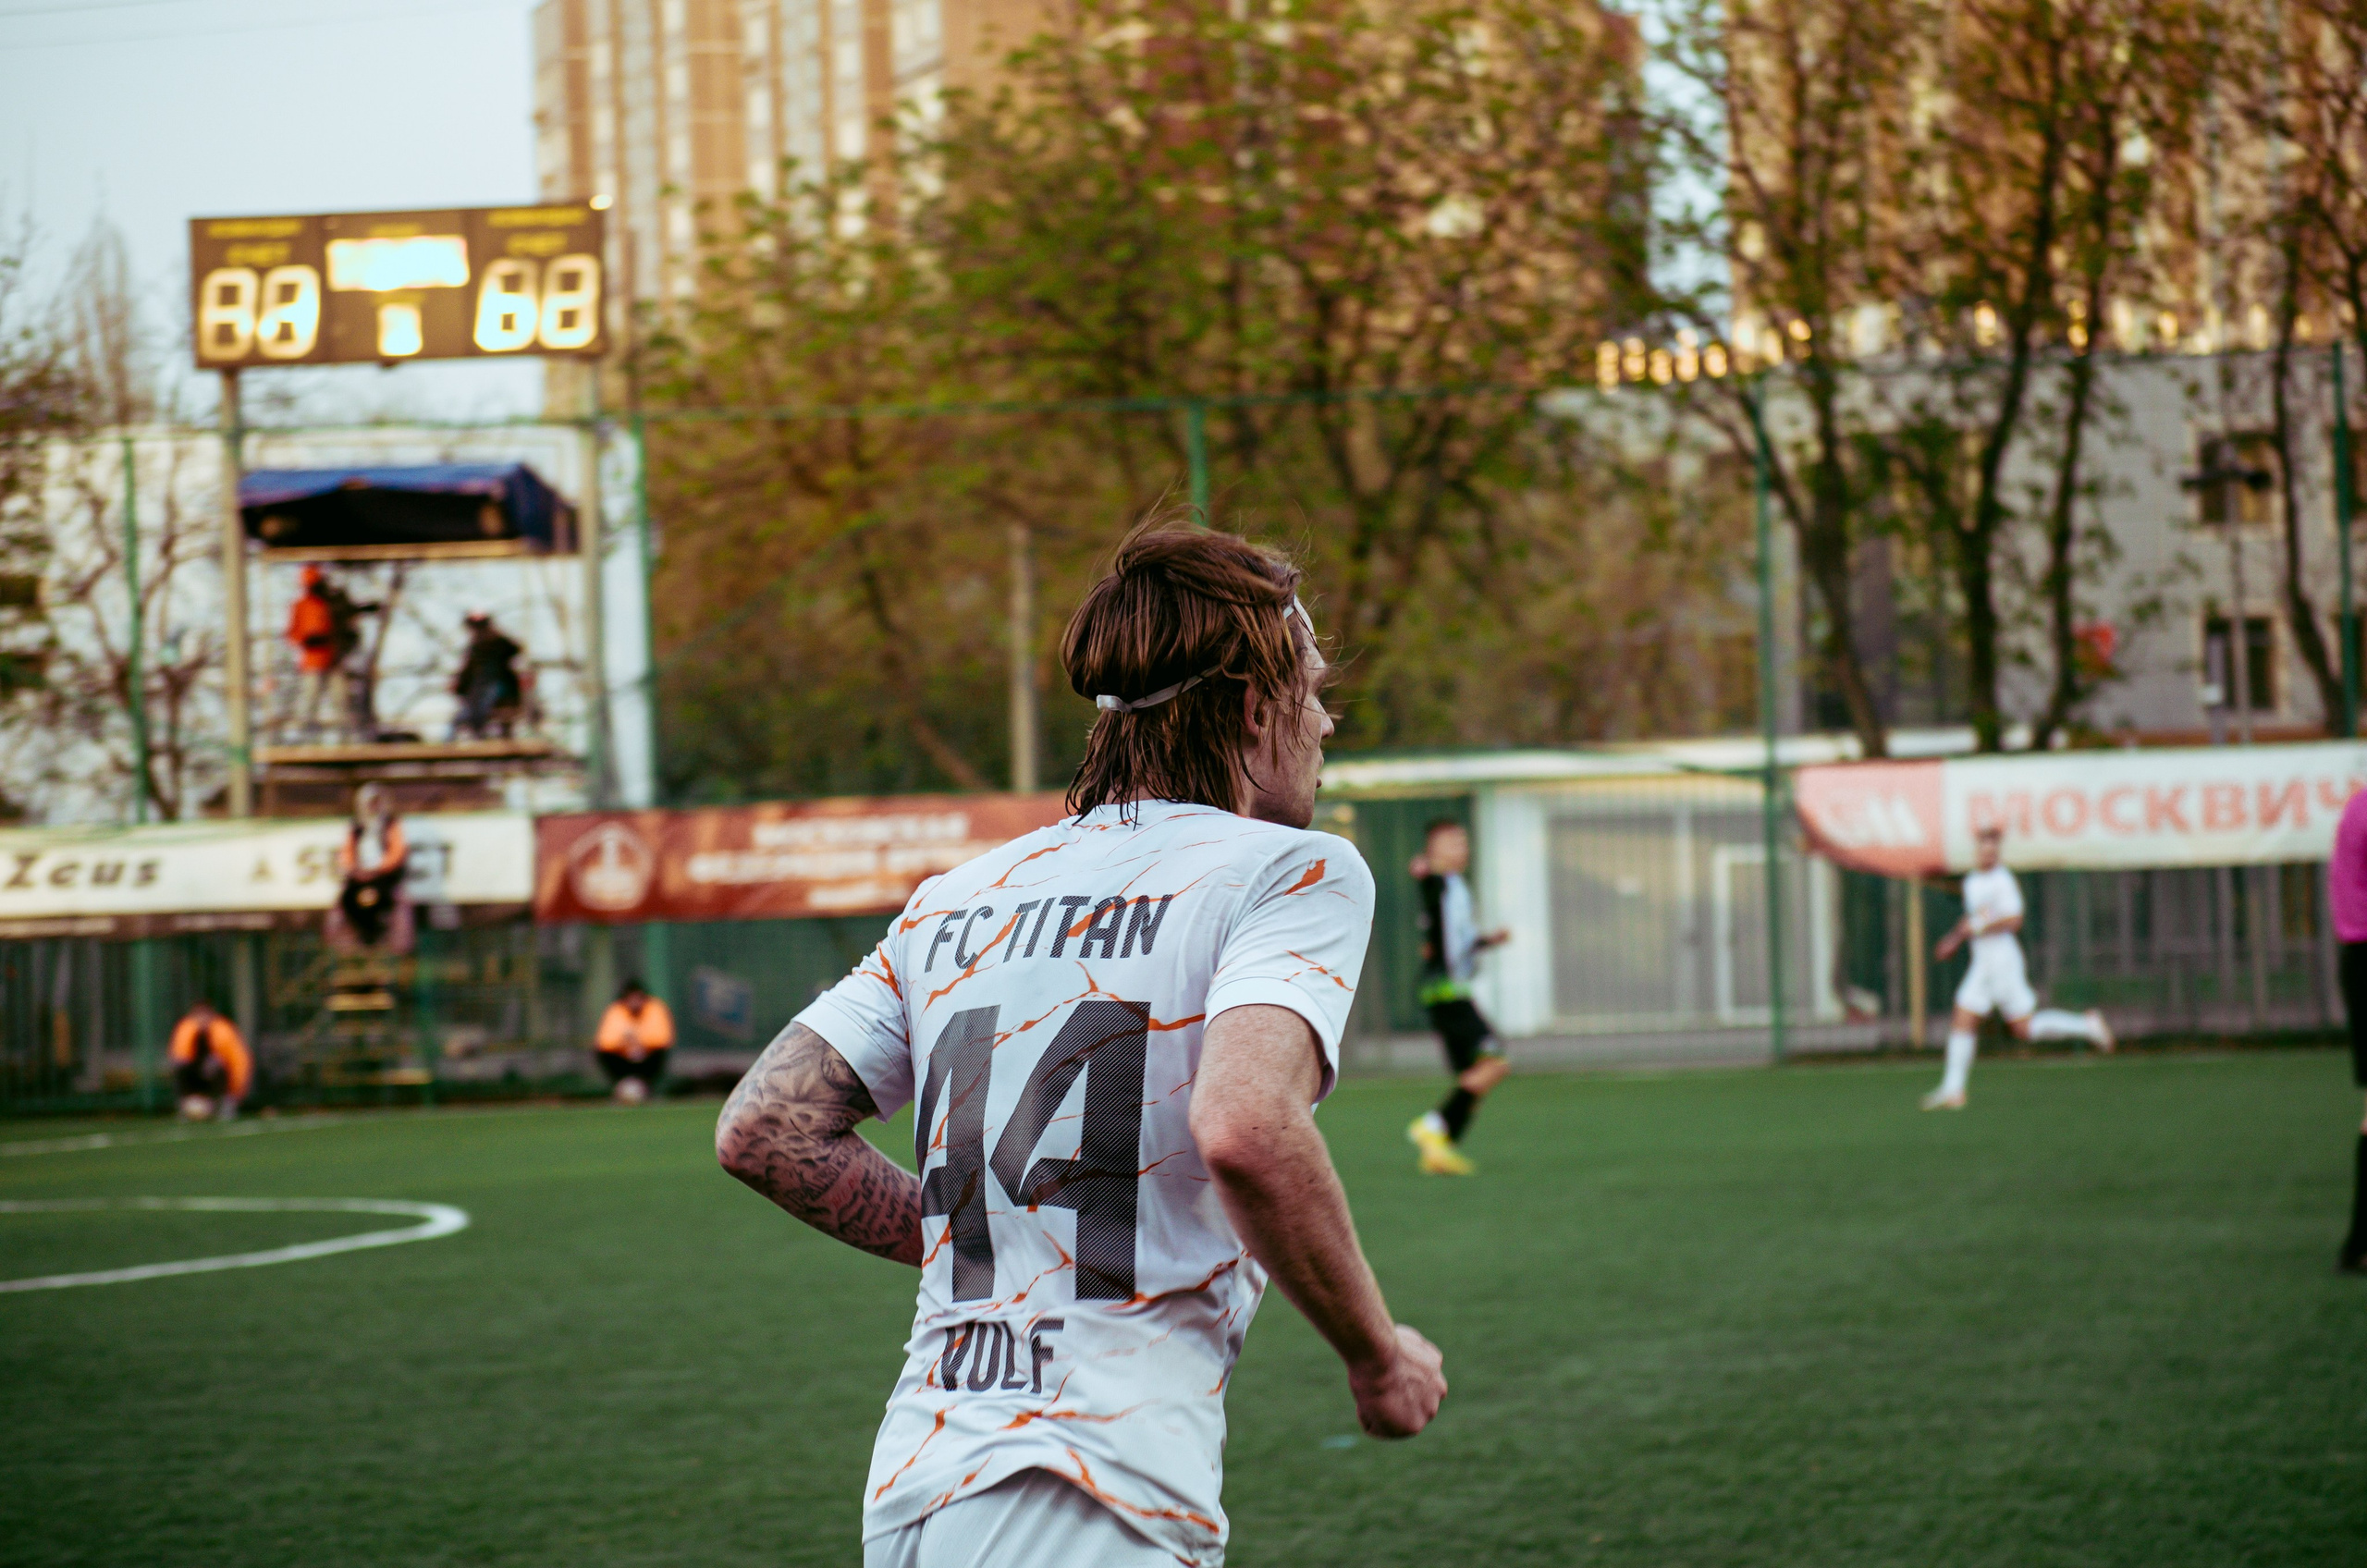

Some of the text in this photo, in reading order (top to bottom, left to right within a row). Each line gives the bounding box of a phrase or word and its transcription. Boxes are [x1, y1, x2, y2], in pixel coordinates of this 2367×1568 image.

[4, 850, 162, 889] Zeus
[924, 893, 1175, 974] FC TITAN
[914, 1000, 1151, 1304] 44
